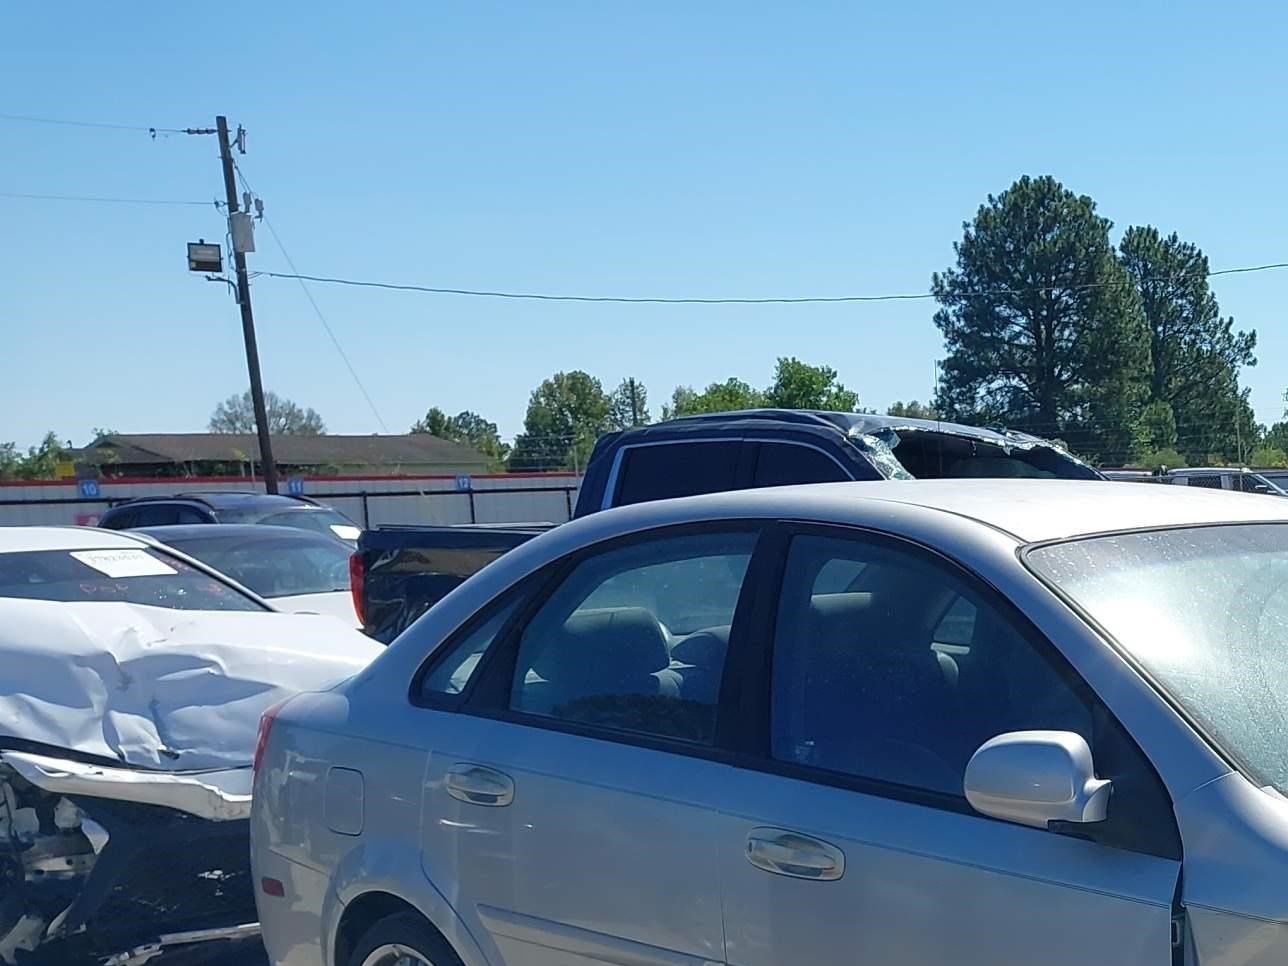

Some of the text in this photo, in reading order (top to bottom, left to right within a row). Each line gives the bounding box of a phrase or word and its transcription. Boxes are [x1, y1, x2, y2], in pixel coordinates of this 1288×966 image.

[83, 483, 97, 496] 10
[291, 480, 302, 493] 11
[459, 478, 469, 489] 12
